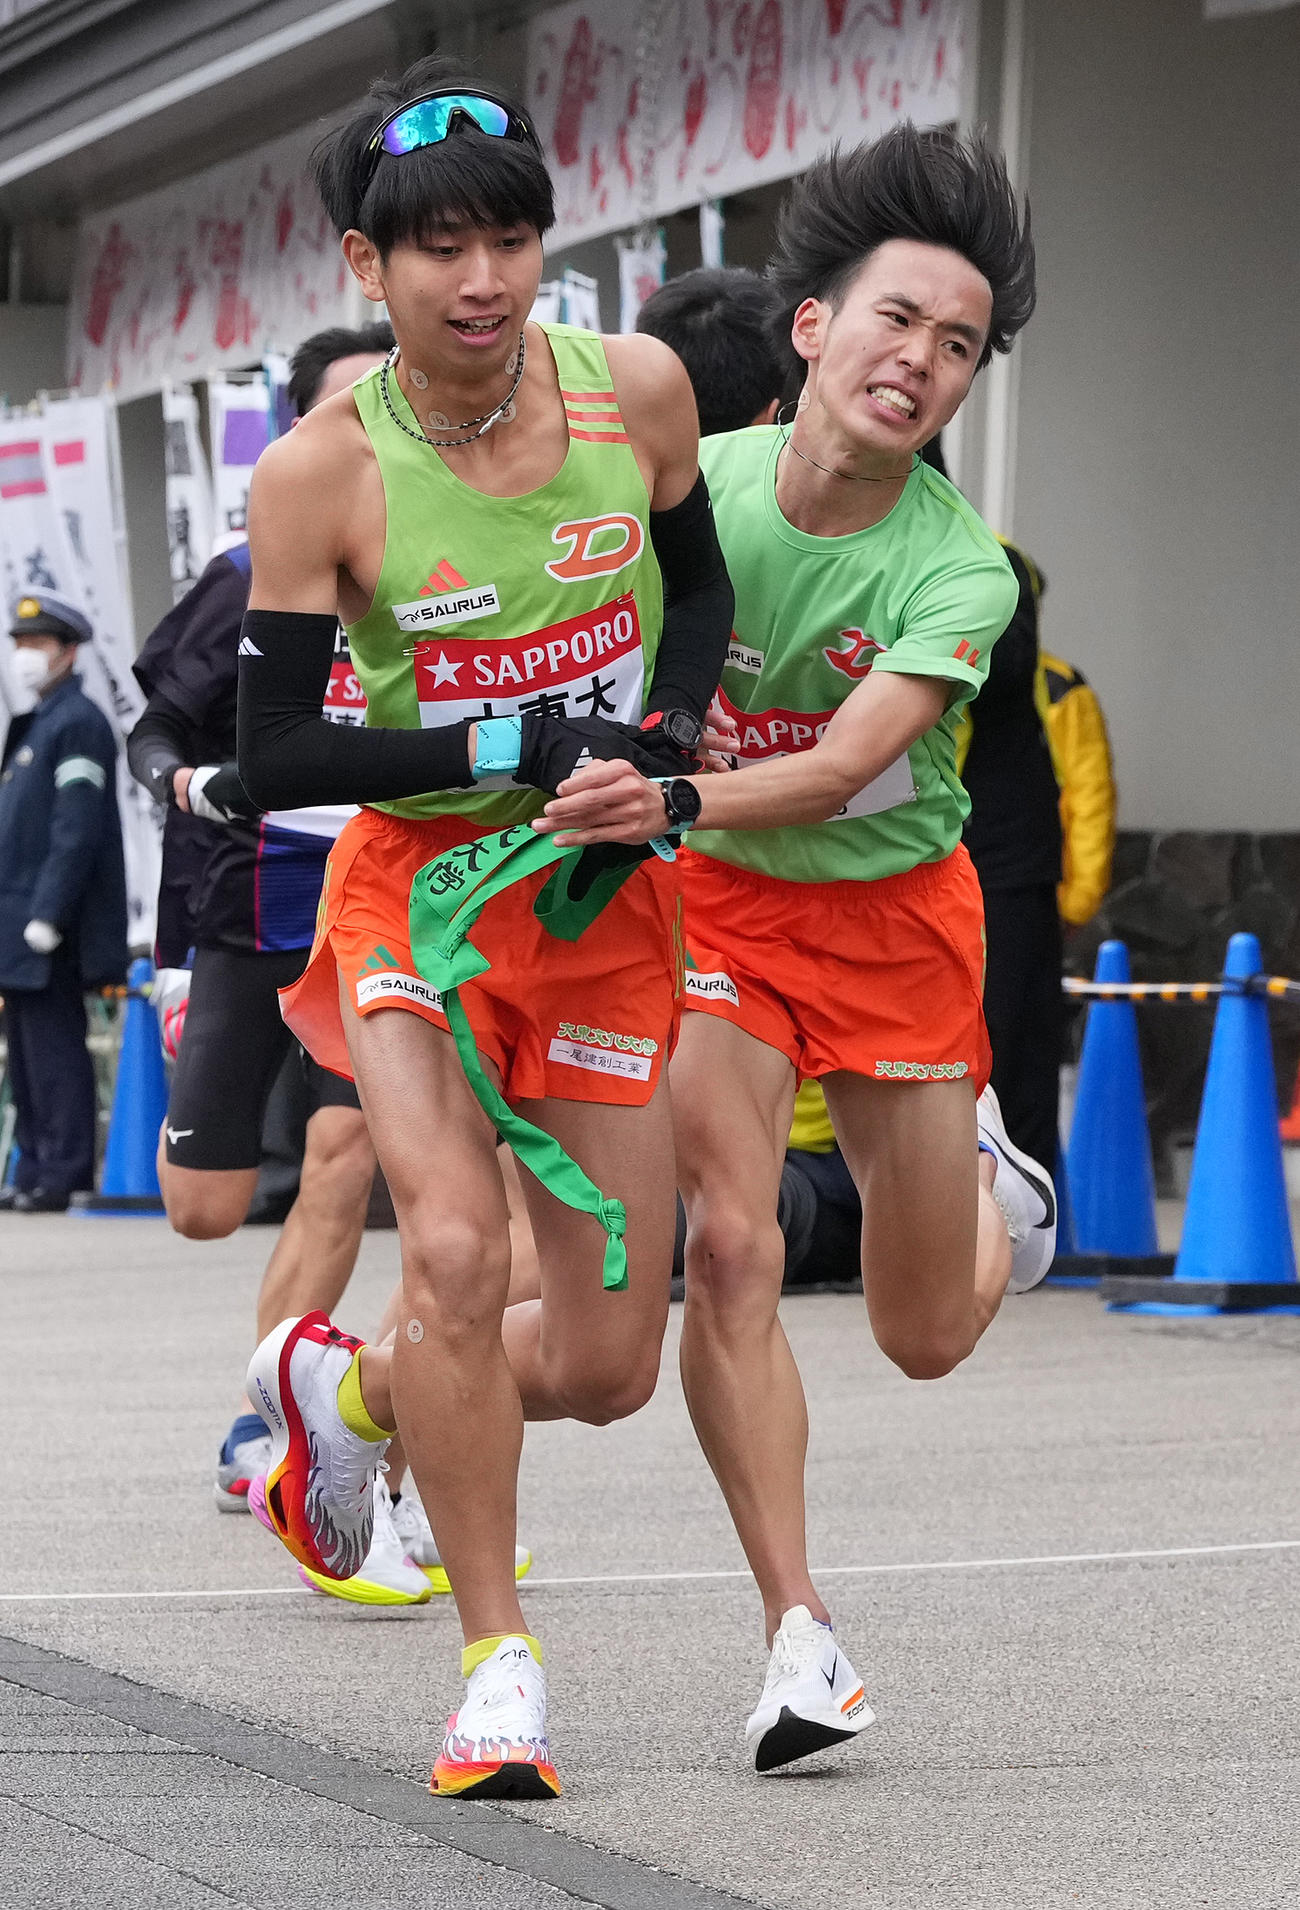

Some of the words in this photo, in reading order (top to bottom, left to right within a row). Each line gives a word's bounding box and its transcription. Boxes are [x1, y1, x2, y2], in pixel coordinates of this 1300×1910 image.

[544, 512, 645, 583] D
[421, 594, 496, 621] SAURUS
[472, 610, 634, 686] SAPPORO
[687, 978, 737, 998] AURUS
